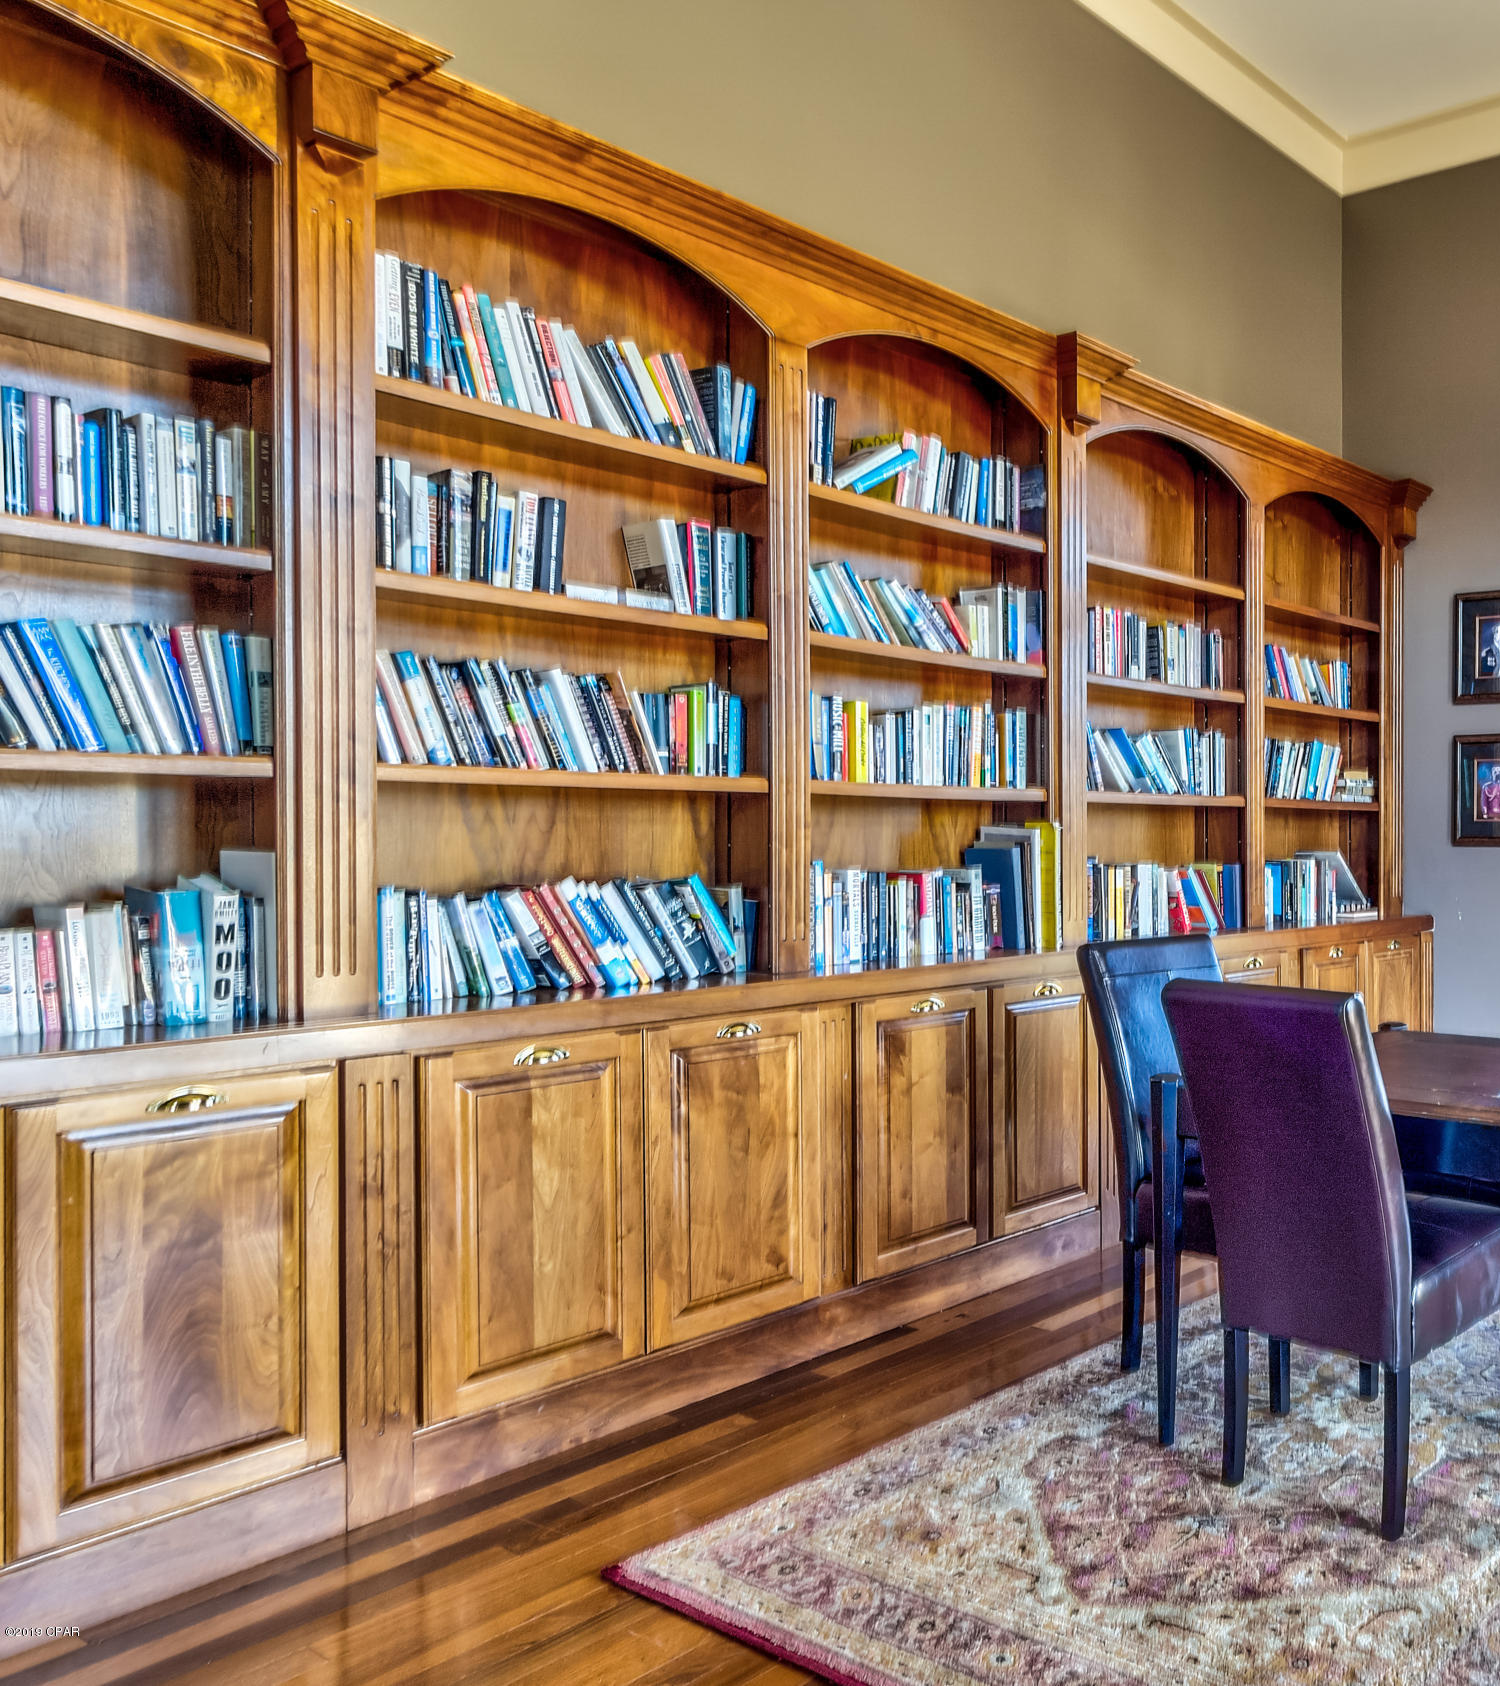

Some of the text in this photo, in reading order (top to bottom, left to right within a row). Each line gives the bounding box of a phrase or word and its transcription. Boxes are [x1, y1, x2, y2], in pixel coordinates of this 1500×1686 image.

[408, 281, 419, 364] BOYS IN WHITE
[180, 631, 195, 653] FIRE
[190, 665, 206, 686] THE
[194, 686, 213, 714] BELLY
[833, 695, 843, 753] MUSIC MILL
[214, 923, 236, 1001] MOO
